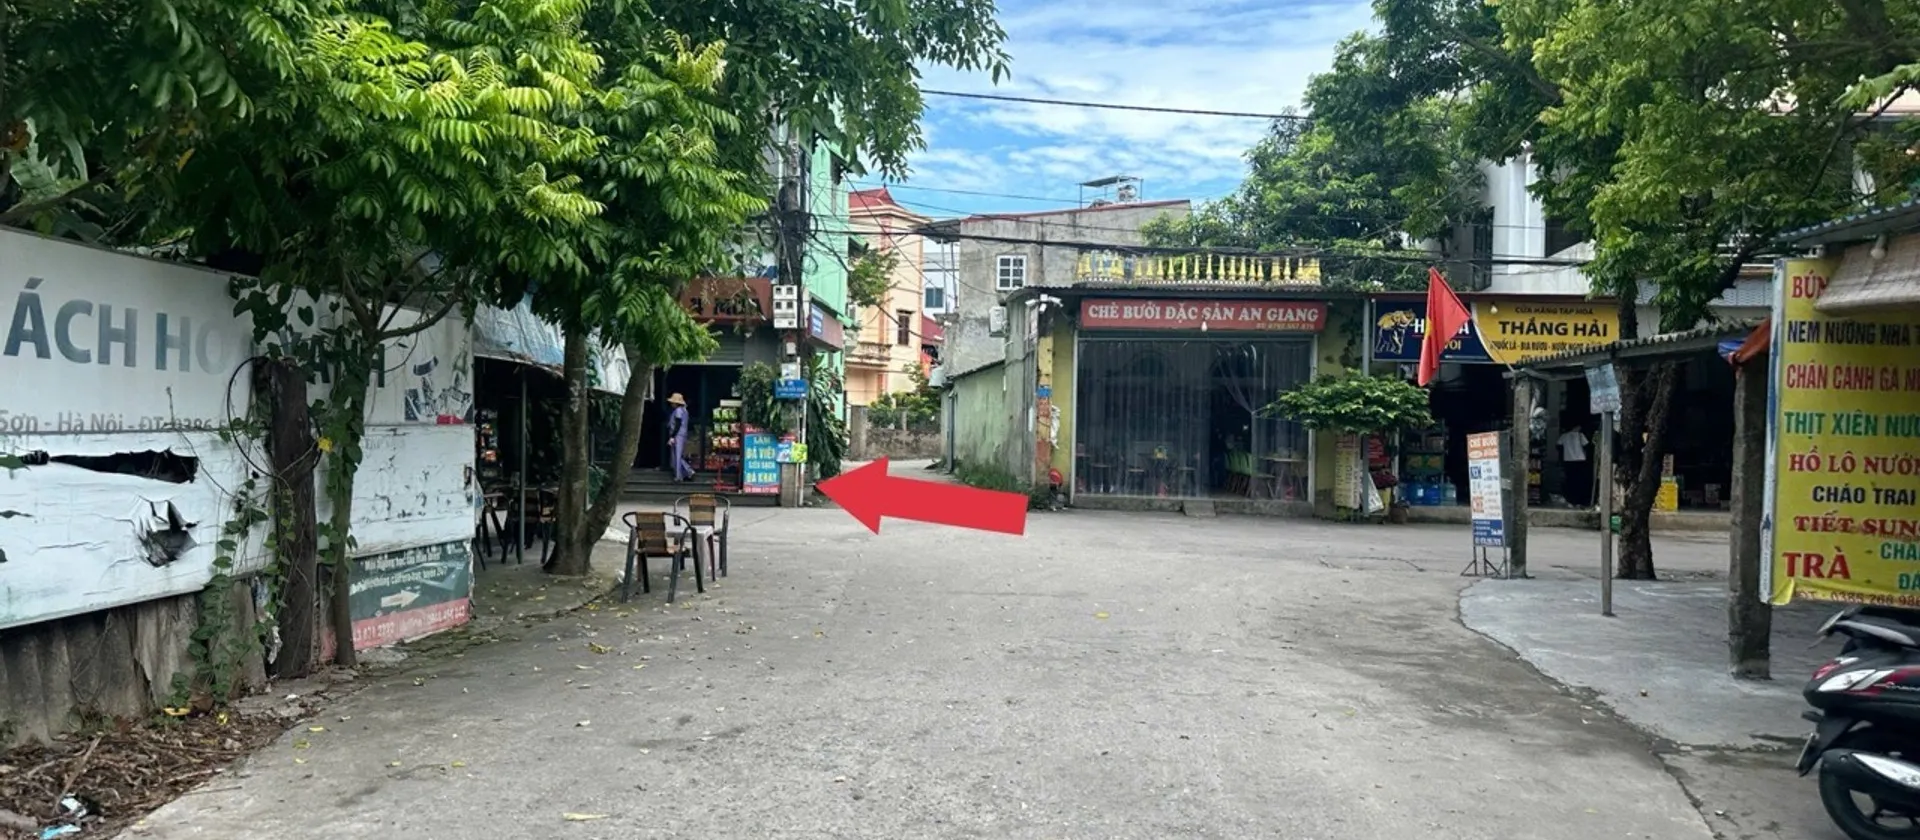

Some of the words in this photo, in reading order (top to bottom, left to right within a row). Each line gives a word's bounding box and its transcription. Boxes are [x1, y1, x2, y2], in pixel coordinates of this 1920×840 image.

[1088, 302, 1119, 319] CHÈ
[1123, 301, 1161, 320] BƯỞI
[1165, 303, 1198, 323] ĐẶC
[1201, 302, 1235, 321] SẢN
[1239, 307, 1263, 321] AN
[1266, 307, 1319, 322] GIANG
[4, 277, 138, 367] ÁCH
[155, 312, 250, 376] HO
[1499, 317, 1568, 336] THẮNG
[1573, 319, 1608, 337] HẢI
[1788, 320, 1820, 343] NEM
[59, 410, 84, 433] Hà
[1784, 411, 1826, 440] THỊT
[1832, 408, 1877, 437] XIÊN
[1828, 450, 1856, 473] LÔ
[1812, 483, 1866, 504] CHÁO
[1872, 487, 1916, 506] TRAI
[1794, 510, 1855, 533] TIẾT
[1783, 545, 1851, 580] TRÀ
[1880, 541, 1920, 560] CHA
